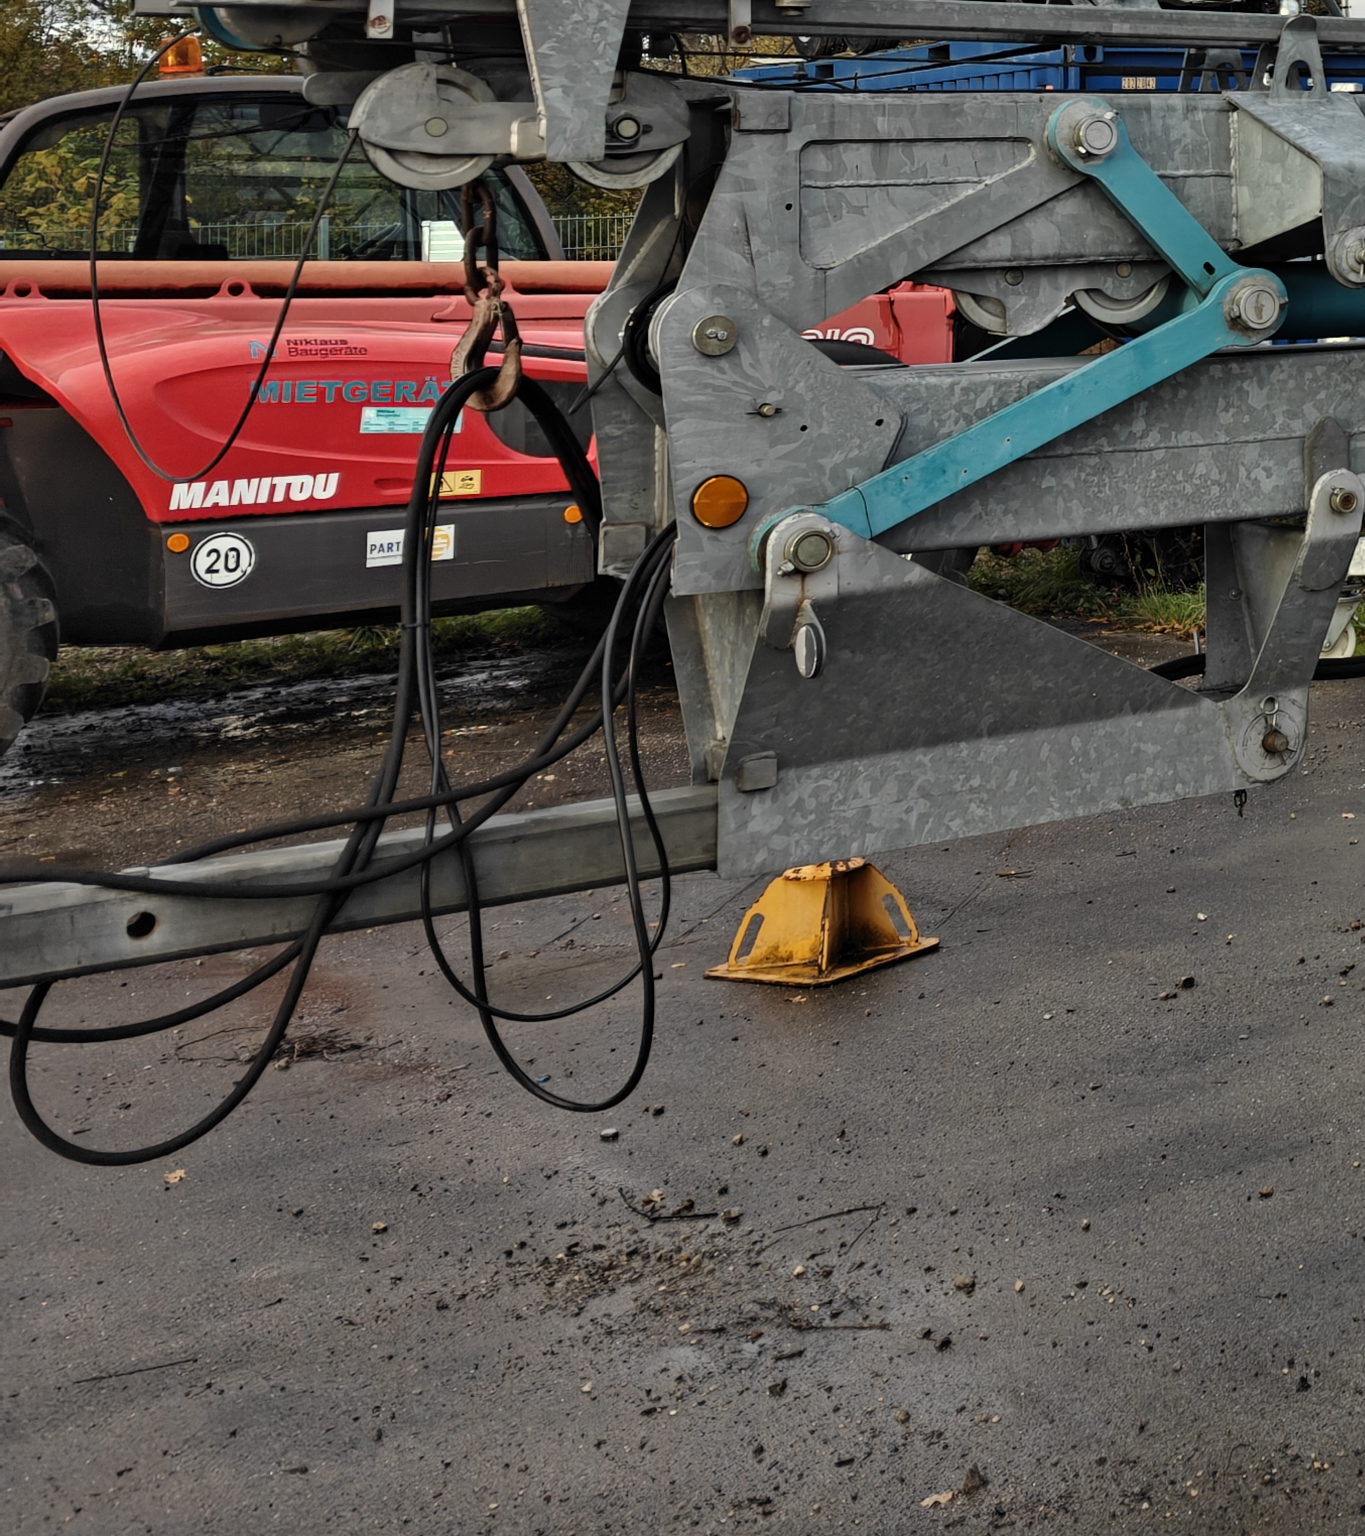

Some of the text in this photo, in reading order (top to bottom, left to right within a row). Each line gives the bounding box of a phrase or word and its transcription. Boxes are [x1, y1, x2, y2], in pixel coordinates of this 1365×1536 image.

[288, 347, 368, 358] Baugeräte
[169, 472, 341, 510] MANITOU
[370, 540, 402, 555] PART
[205, 547, 241, 574] 20
